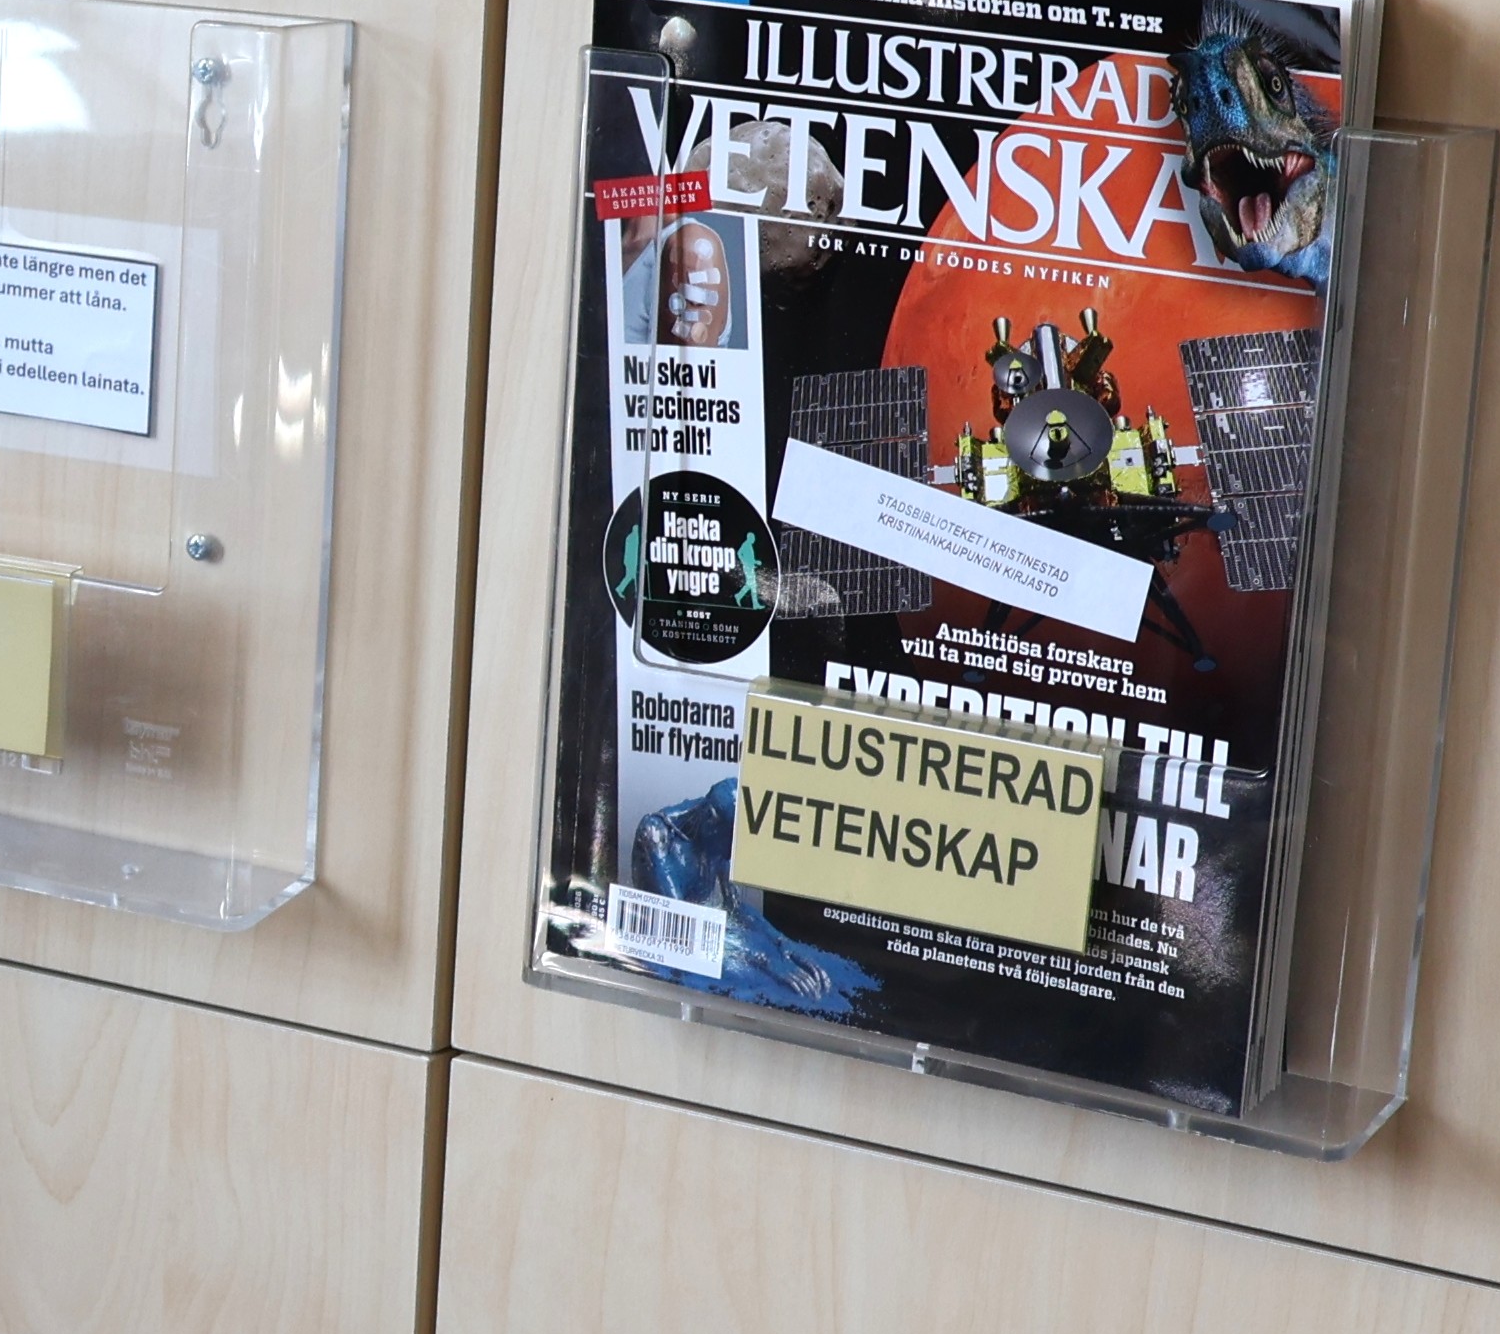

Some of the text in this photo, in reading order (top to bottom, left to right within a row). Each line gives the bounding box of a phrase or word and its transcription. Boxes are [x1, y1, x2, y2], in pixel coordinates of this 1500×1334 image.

[1047, 0, 1086, 24] om
[1092, 6, 1115, 31] T.
[1122, 12, 1164, 34] rex
[744, 18, 1179, 130] ILLUSTRERAD
[22, 255, 74, 280] längre
[78, 264, 114, 282] men
[119, 268, 147, 287] det
[807, 233, 1111, 289] FÖR ATT DU FÖDDES NYFIKEN
[59, 287, 81, 305] att
[85, 289, 126, 312] låna.
[4, 333, 53, 356] mutta
[6, 361, 78, 386] edelleen
[81, 369, 144, 396] lainata.
[632, 690, 736, 730] Robotarna
[632, 724, 743, 763] blir flytand
[748, 707, 1094, 816] ILLUSTRERAD
[741, 790, 1039, 887] VETENSKAP
